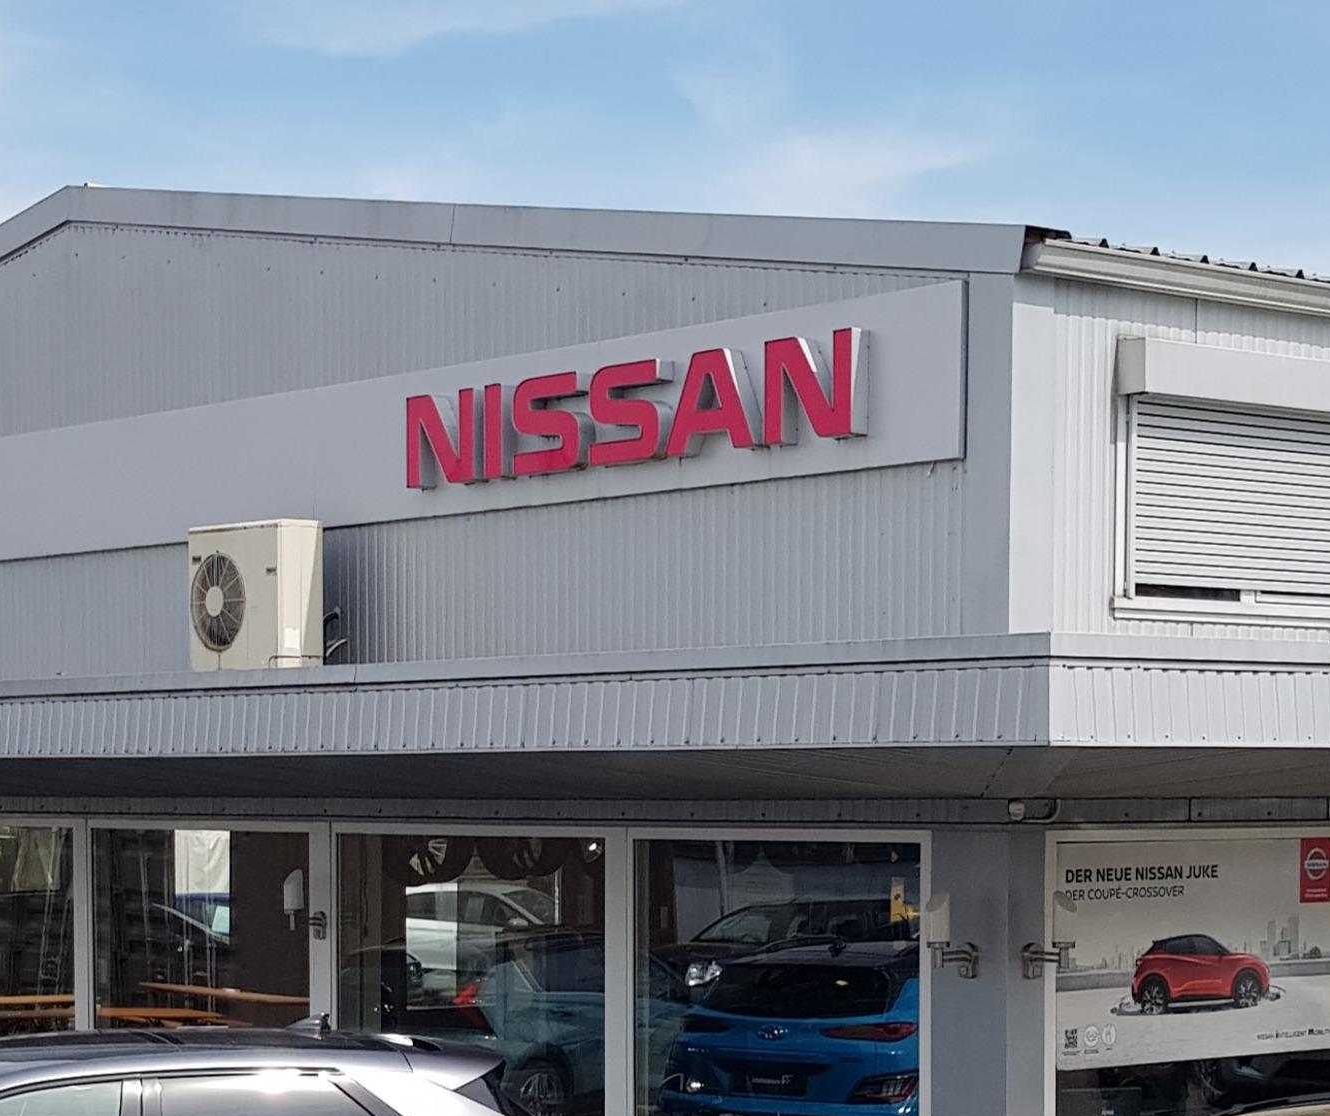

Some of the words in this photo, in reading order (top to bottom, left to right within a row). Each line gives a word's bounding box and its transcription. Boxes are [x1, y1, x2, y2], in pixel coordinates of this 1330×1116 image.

[405, 327, 861, 489] NISSAN
[1065, 869, 1093, 884] DER
[1096, 867, 1132, 883] NEUE
[1135, 866, 1183, 880] NISSAN
[1186, 864, 1219, 879] JUKE
[1087, 885, 1185, 900] COUPÉ-CROSSOVER
